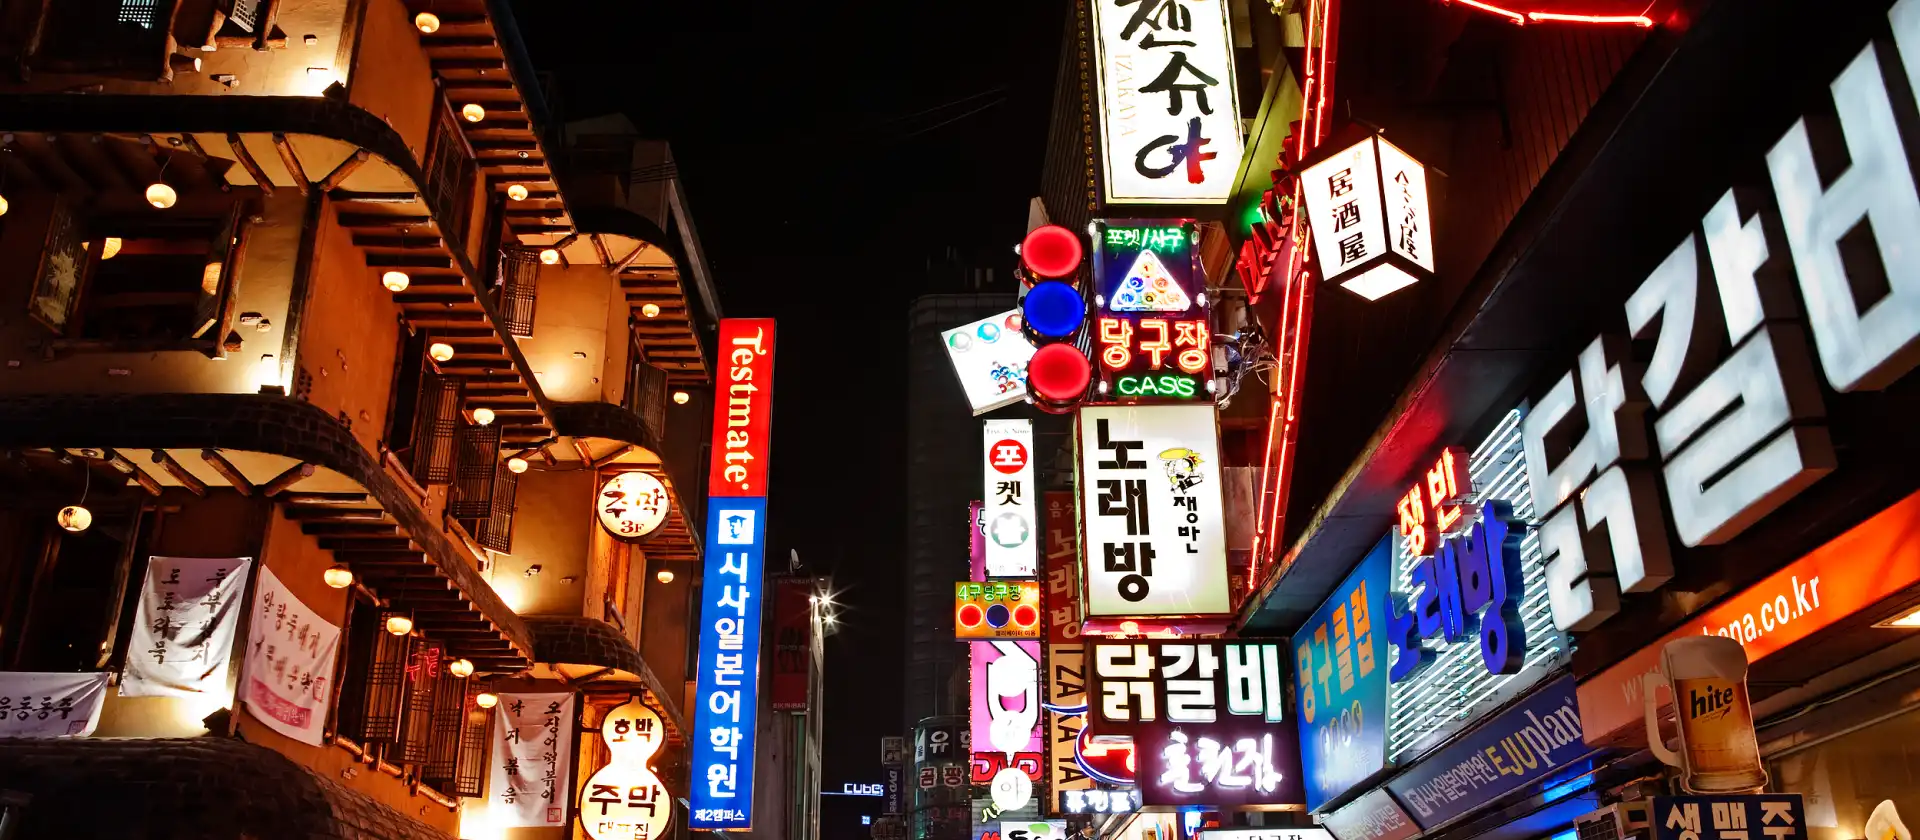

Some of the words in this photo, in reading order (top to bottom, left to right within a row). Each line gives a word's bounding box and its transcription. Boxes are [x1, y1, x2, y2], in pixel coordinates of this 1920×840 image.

[1115, 54, 1137, 137] IZAKAYA
[1327, 167, 1368, 267] 居酒屋
[1100, 318, 1209, 372] 당구장
[1118, 376, 1196, 396] CASS
[993, 445, 1025, 506] 포켓
[1396, 446, 1462, 557] 쟁반
[620, 520, 645, 534] 3F
[1096, 418, 1157, 603] 노래방
[1173, 496, 1201, 554] 쟁반
[1384, 498, 1511, 687] 노래방
[706, 552, 750, 798] 시사일본어학원
[1297, 578, 1376, 725] 당구클럽
[1095, 644, 1283, 724] 닭갈비
[1690, 684, 1734, 720] hite
[612, 718, 654, 743] 호박
[1485, 704, 1582, 776] EJUplan
[588, 783, 661, 818] 주막
[694, 808, 746, 821] 제2캠퍼스
[1665, 801, 1796, 840] 생맥주
